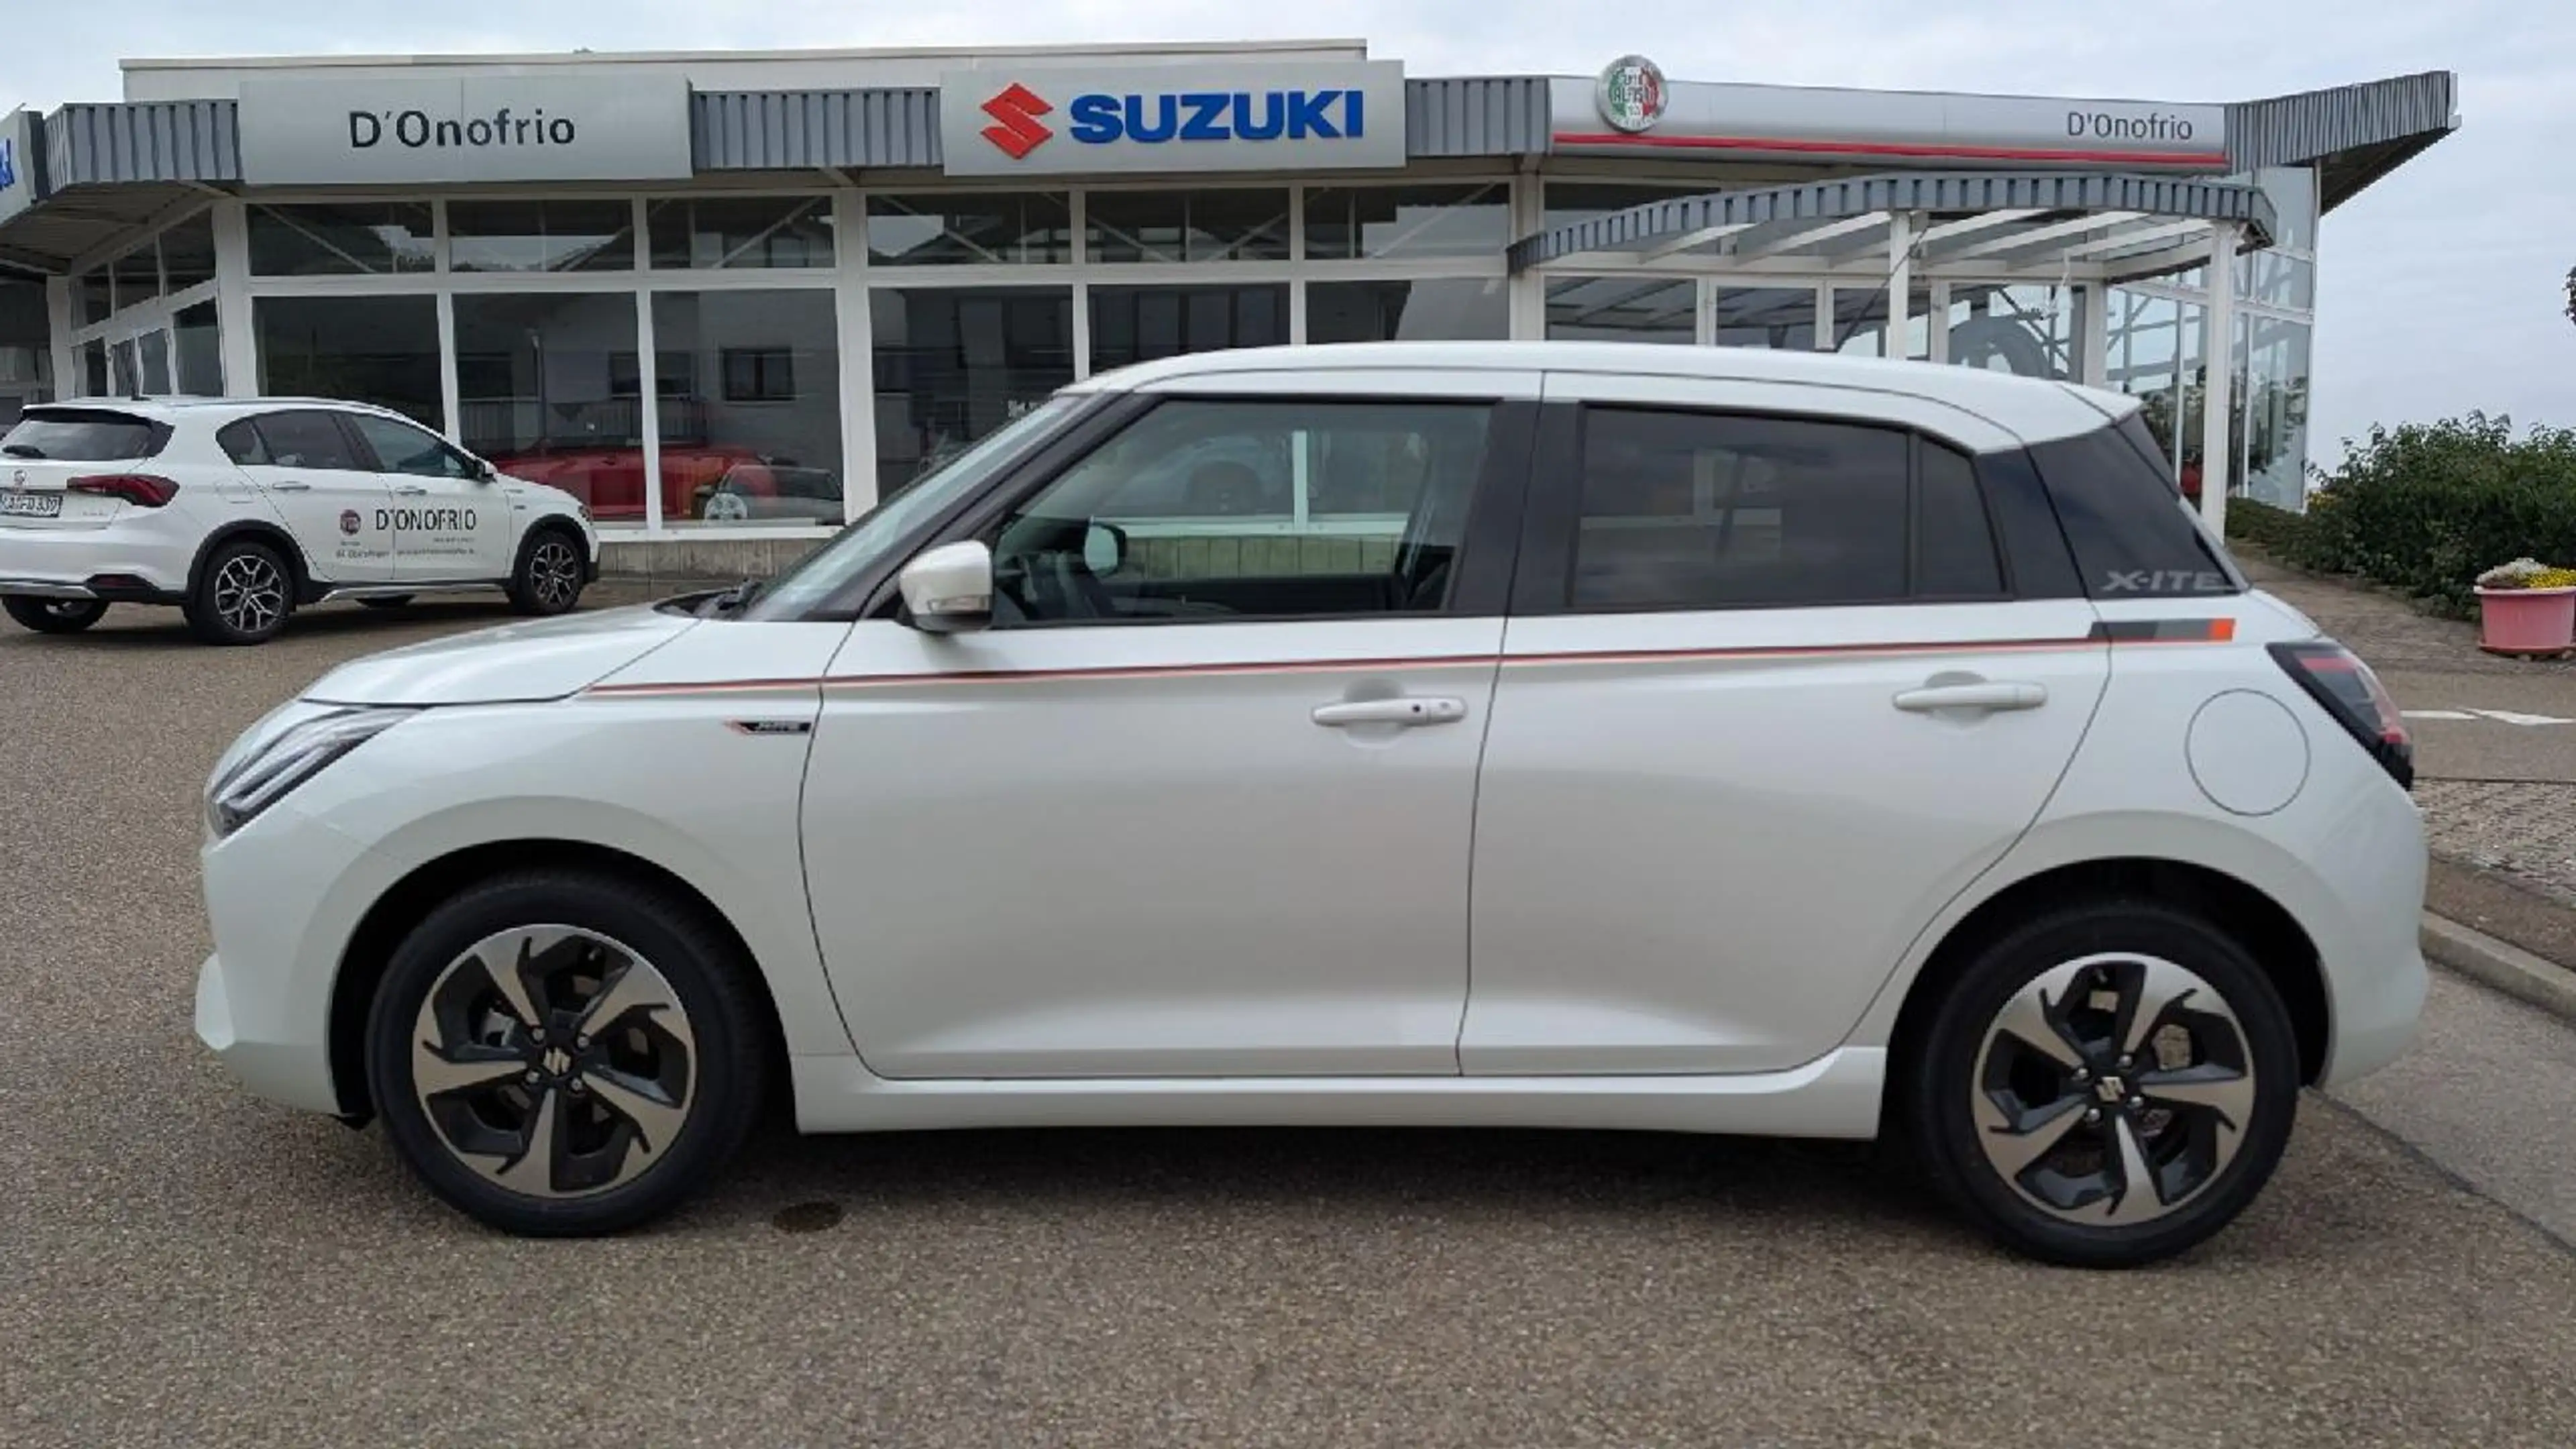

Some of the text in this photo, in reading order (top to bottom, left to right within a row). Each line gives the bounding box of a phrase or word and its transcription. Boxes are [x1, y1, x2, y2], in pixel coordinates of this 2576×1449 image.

[1070, 90, 1364, 144] SUZUKI
[2068, 111, 2193, 140] D'Onofrio
[376, 508, 476, 531] D'ONOFRIO
[2102, 570, 2238, 591] X-ITE
